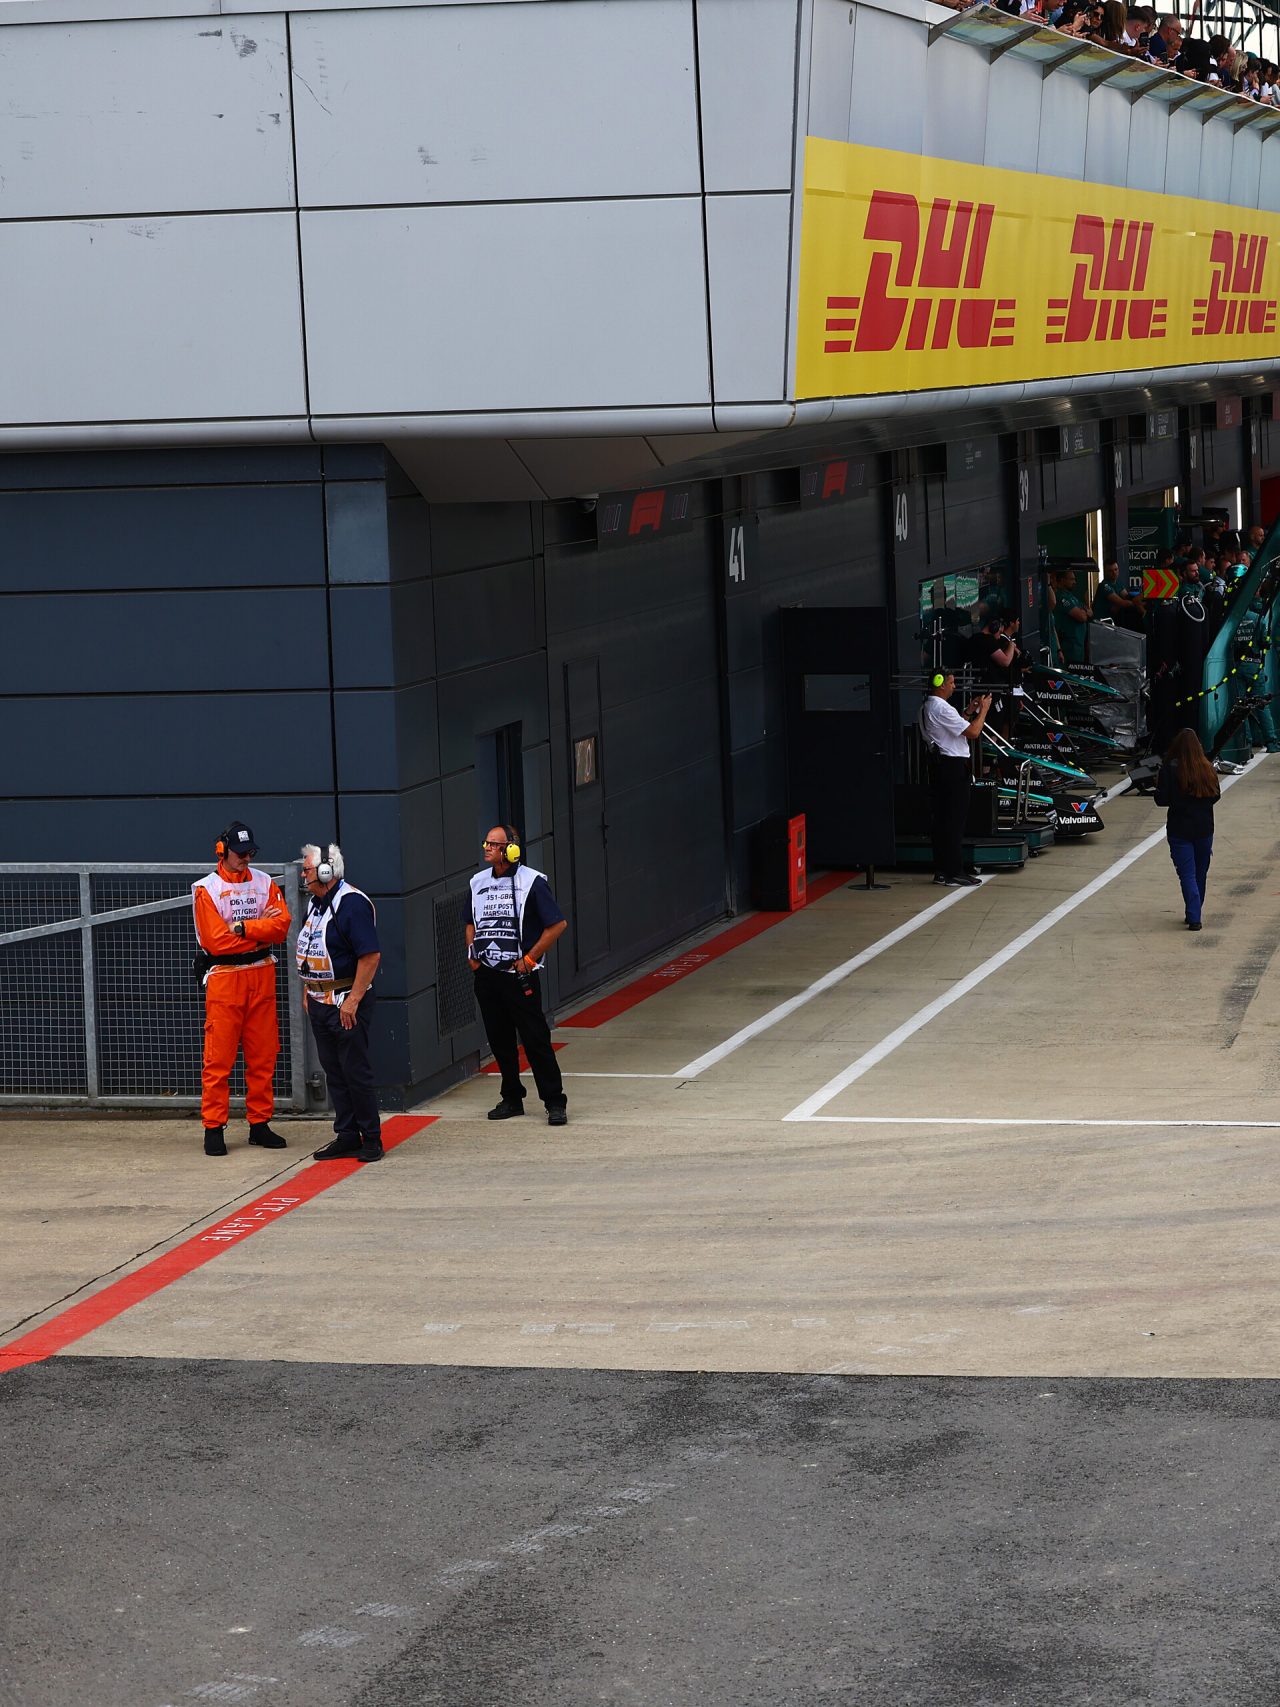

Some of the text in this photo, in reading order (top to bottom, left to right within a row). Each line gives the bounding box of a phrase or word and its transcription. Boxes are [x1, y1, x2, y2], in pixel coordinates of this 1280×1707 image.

[854, 189, 996, 353] DHL
[1064, 214, 1154, 342] DHL
[1204, 229, 1269, 335] DHL
[896, 492, 908, 541] 40
[1019, 469, 1029, 512] 39
[729, 526, 745, 582] 41
